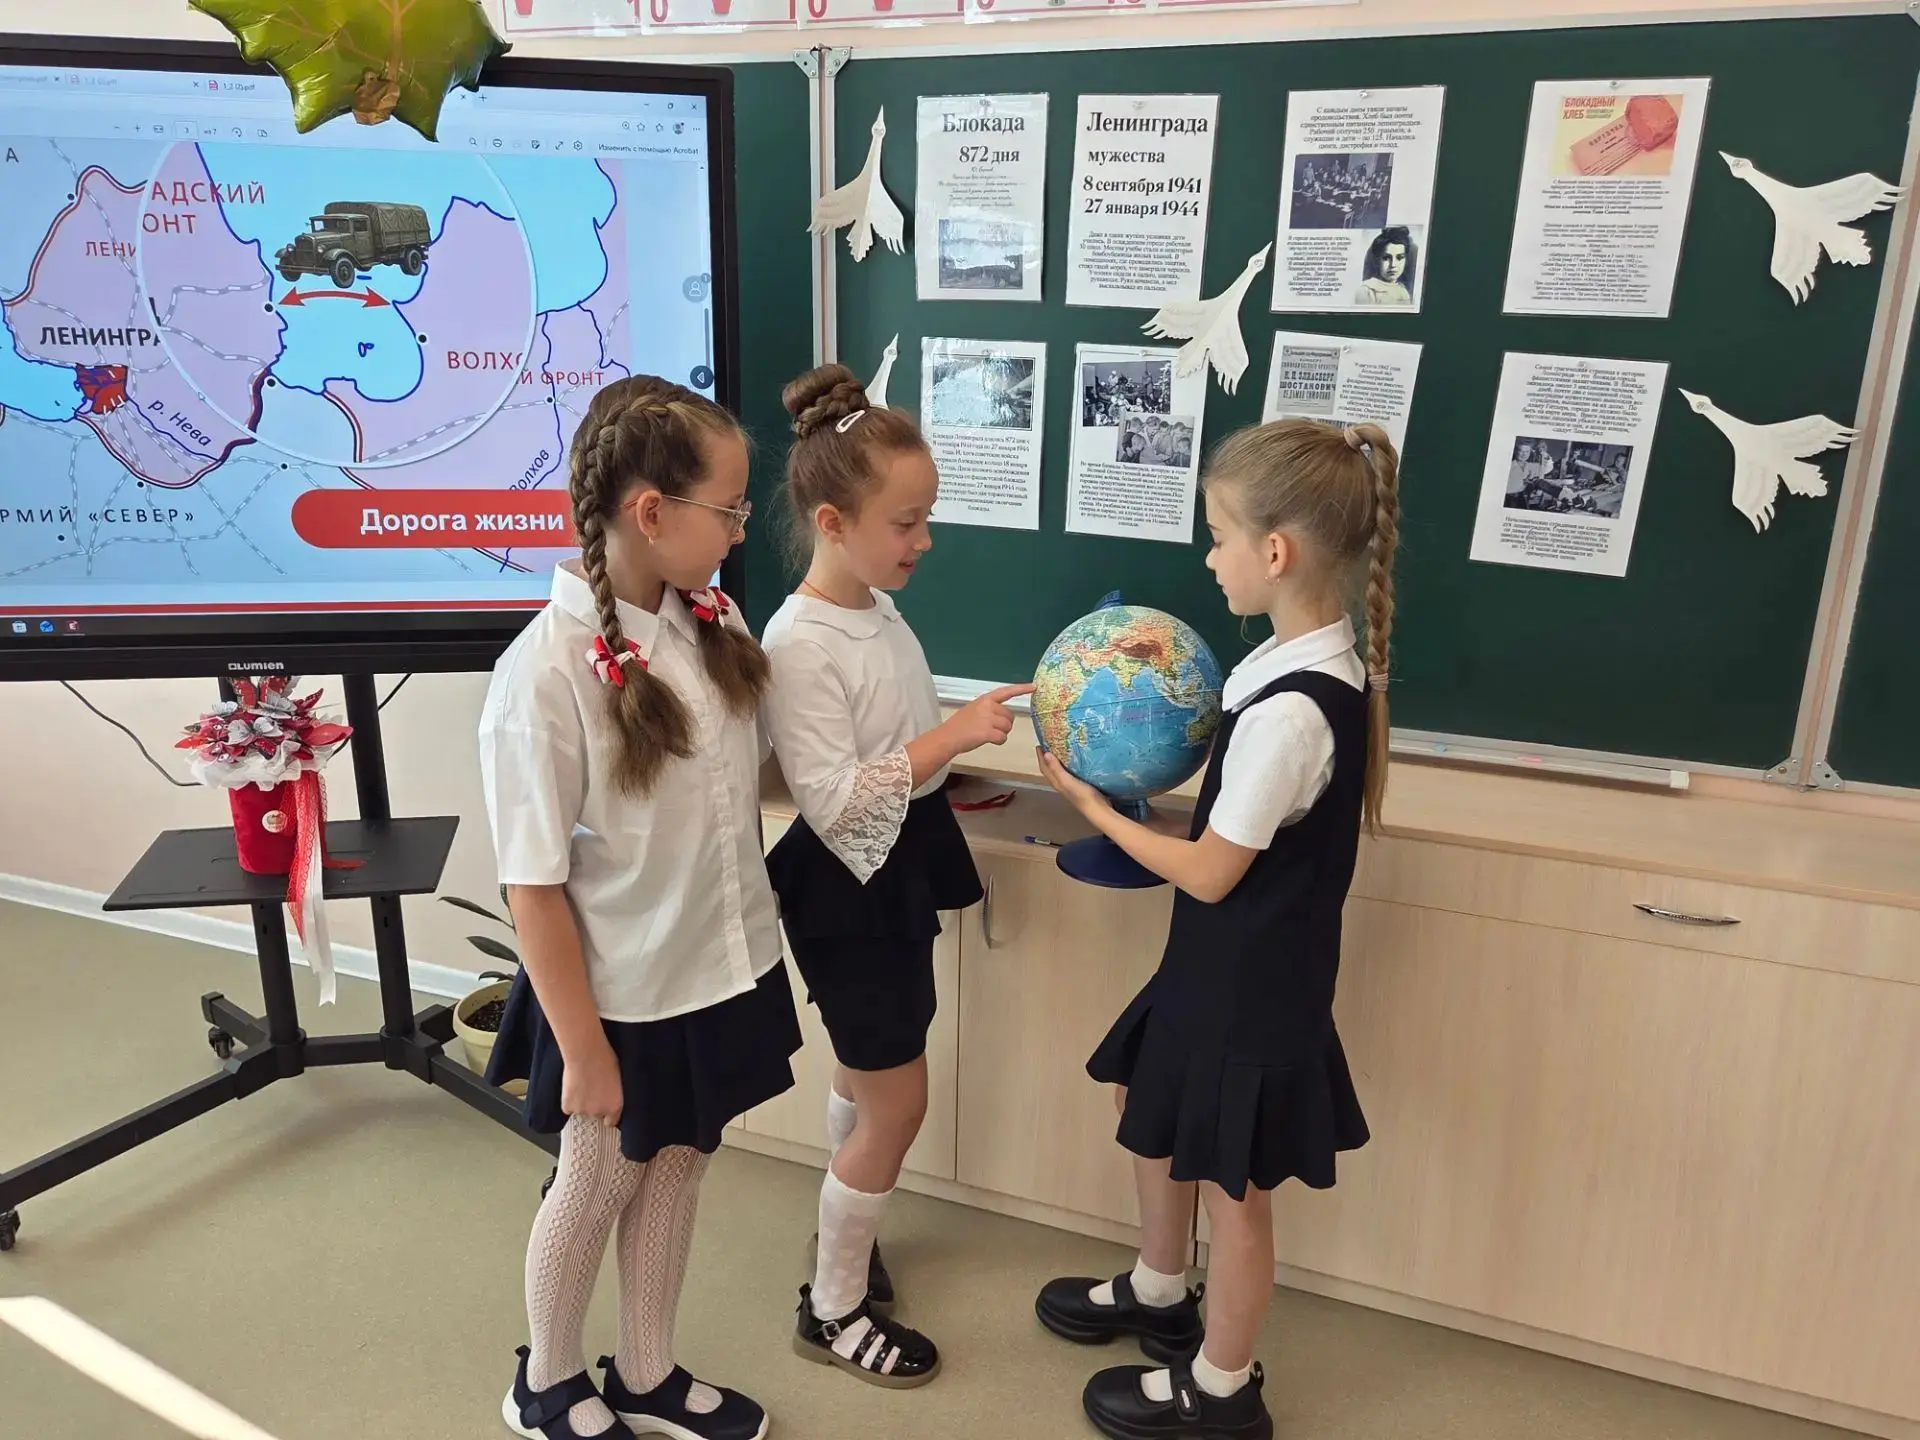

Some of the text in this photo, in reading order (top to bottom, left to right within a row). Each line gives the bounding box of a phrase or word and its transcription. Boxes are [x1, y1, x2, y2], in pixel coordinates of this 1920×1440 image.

[1564, 96, 1615, 108] БЛОКАДНЫЙ
[1562, 109, 1585, 119] ХЛЕБ
[942, 112, 1025, 134] Блокада
[1086, 111, 1208, 137] Ленинграда
[598, 143, 631, 152] Изменить
[673, 146, 699, 155] Acrobat
[959, 145, 1020, 165] 872 дня
[1088, 150, 1165, 165] мужества
[1083, 175, 1202, 195] 8 сентября 1941
[1084, 198, 1199, 218] 27 января 1944
[541, 371, 604, 386] ФРОНТ
[1280, 380, 1336, 391] ШОСТАКОВИЧ
[168, 411, 212, 447] Нева
[89, 508, 194, 523] «СЕВЕР»
[360, 508, 564, 536] Дорога жизни
